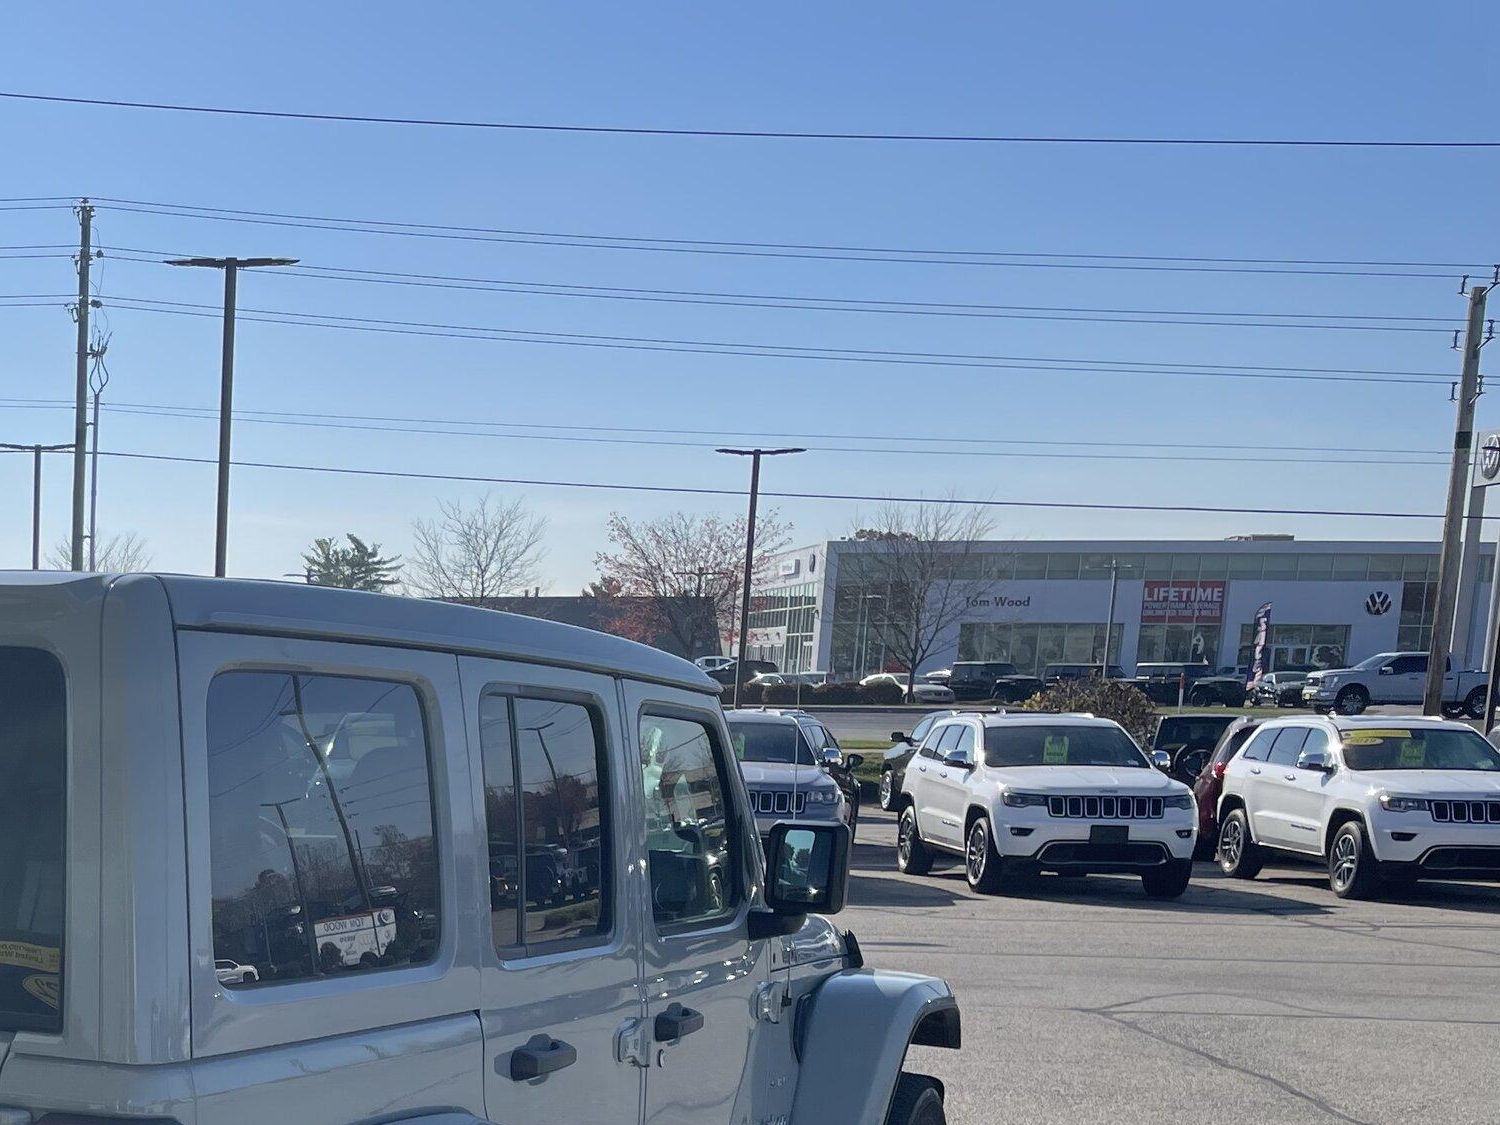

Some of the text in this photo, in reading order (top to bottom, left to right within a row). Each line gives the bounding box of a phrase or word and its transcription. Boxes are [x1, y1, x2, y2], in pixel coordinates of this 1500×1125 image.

[1143, 587, 1224, 602] LIFETIME
[965, 596, 1031, 607] Tom Wood
